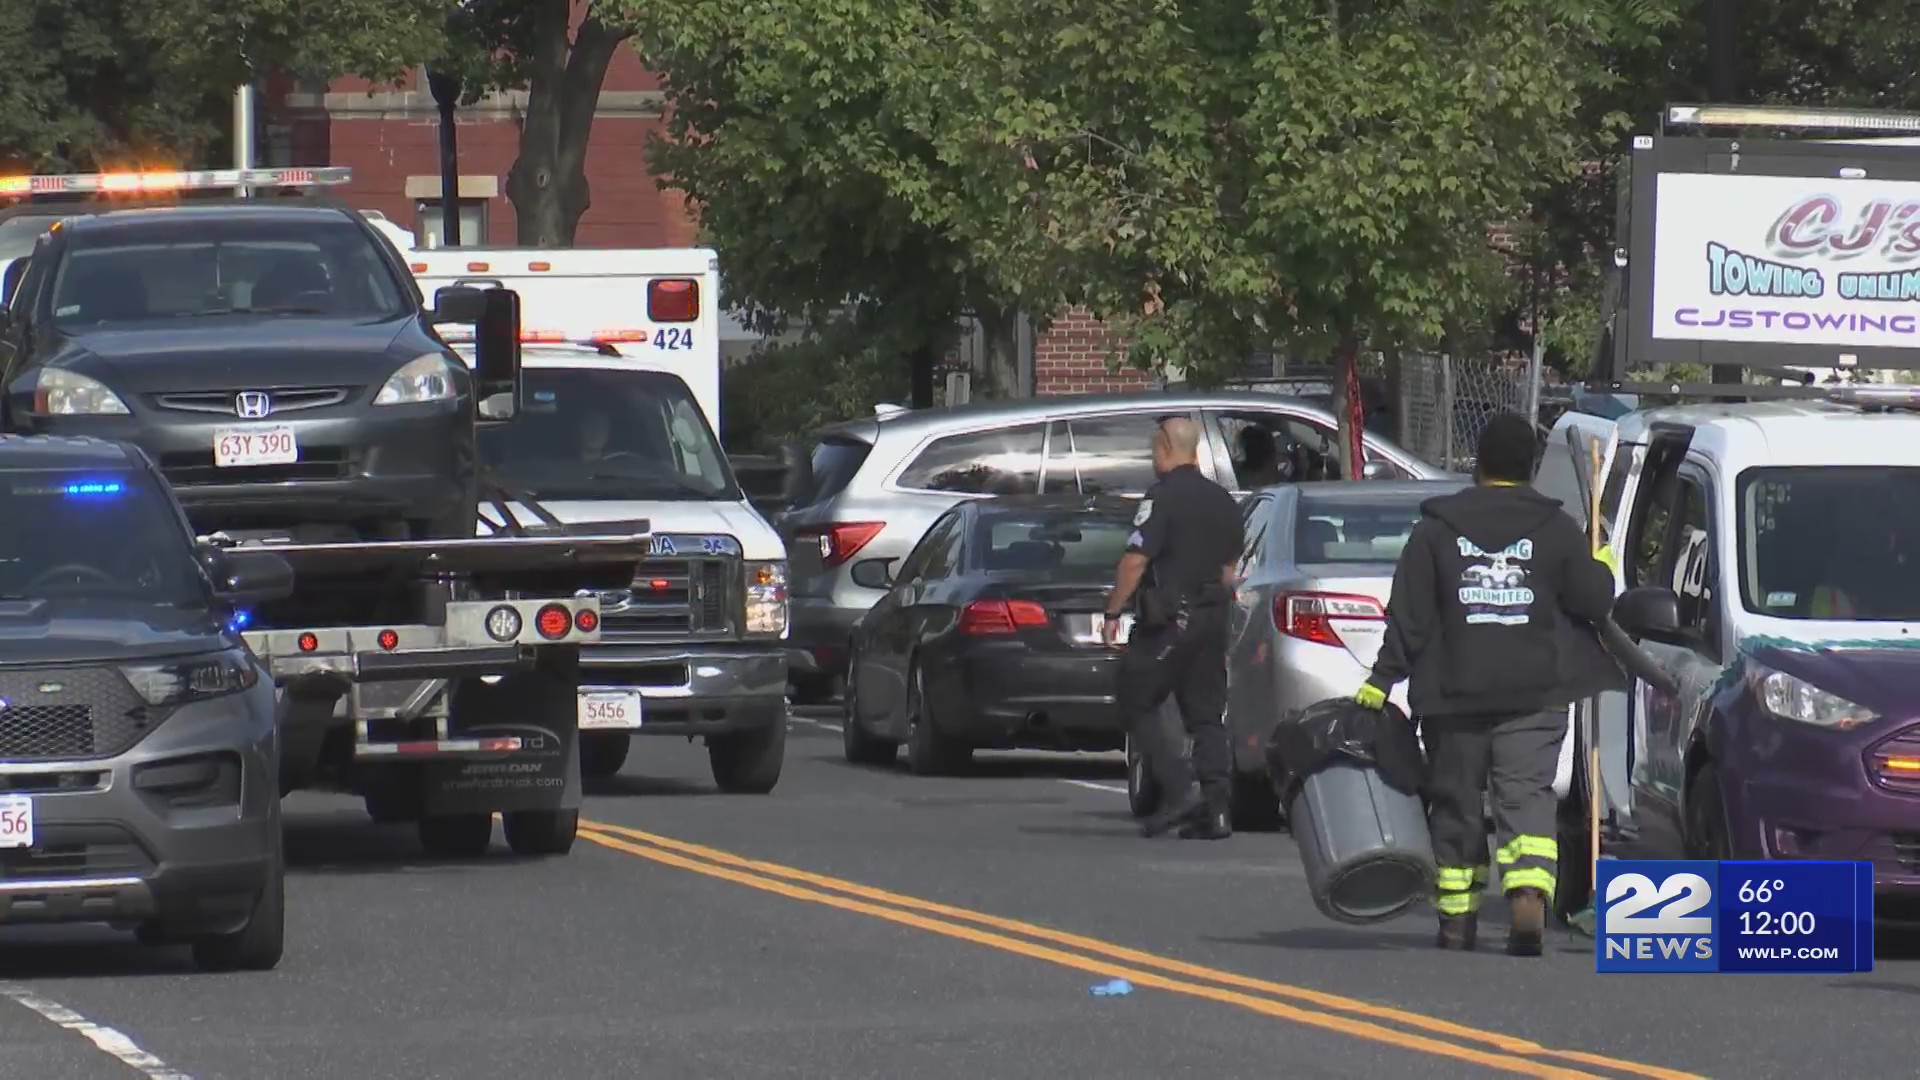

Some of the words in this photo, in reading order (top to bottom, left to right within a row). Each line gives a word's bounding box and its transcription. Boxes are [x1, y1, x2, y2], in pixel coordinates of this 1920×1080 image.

[1707, 241, 1825, 299] TOWING
[1674, 308, 1916, 334] CJSTOWING
[653, 327, 694, 350] 424
[220, 433, 252, 456] 63Y
[258, 433, 291, 455] 390
[1457, 536, 1533, 560] TONG
[1460, 588, 1533, 605] UNLIMITED
[586, 701, 625, 719] 5456
[1, 810, 28, 834] 56
